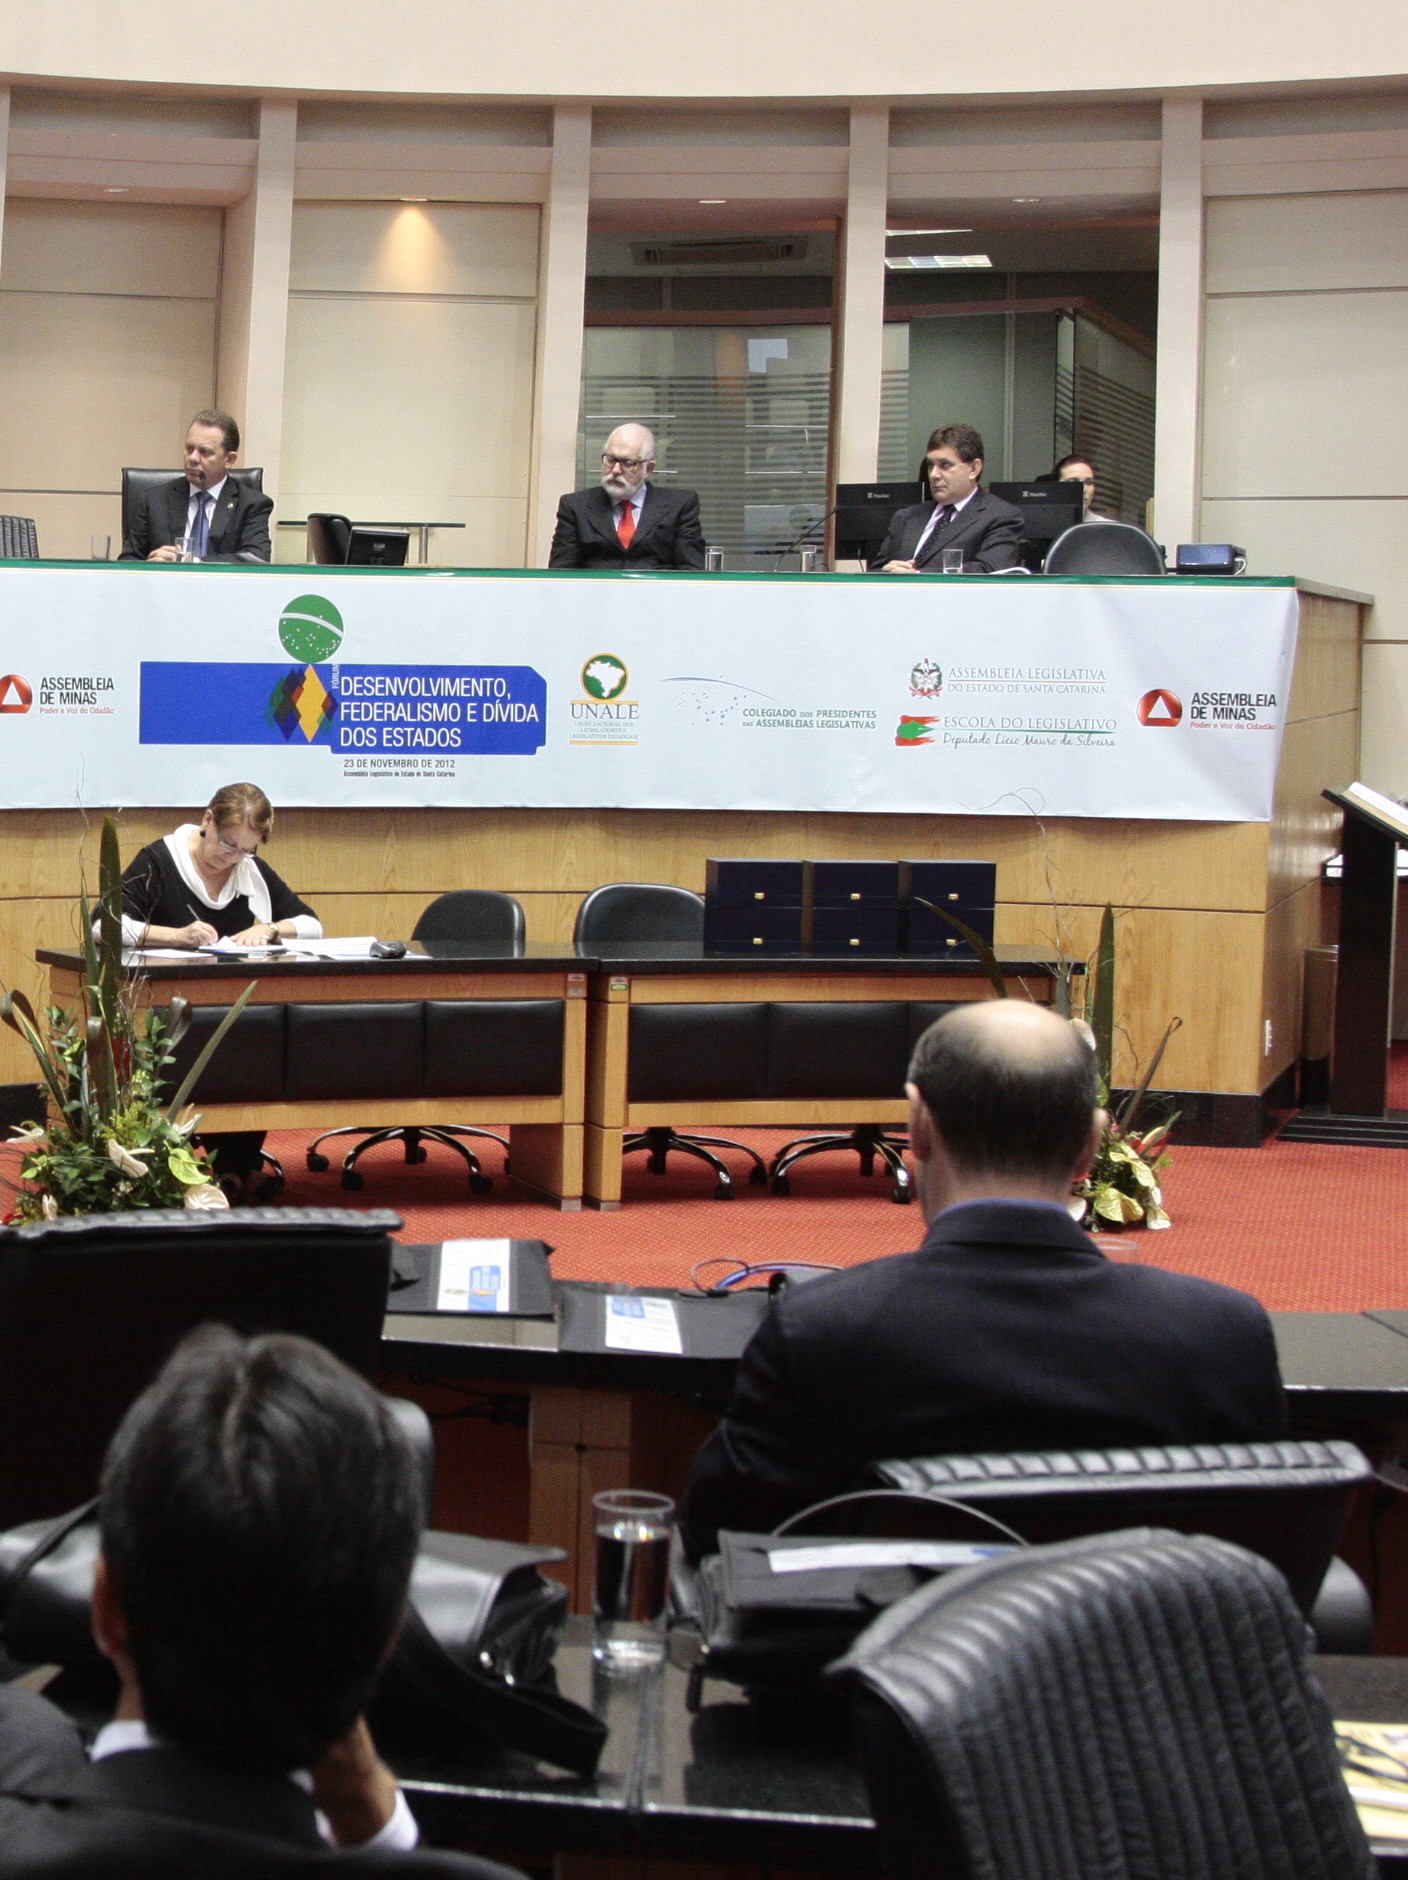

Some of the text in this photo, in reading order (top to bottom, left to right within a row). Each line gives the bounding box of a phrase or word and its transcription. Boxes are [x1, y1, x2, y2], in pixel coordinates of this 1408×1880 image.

[331, 664, 340, 689] FÓRUM
[948, 667, 1106, 680] ASSEMBLEIA LEGISLATIVA
[40, 677, 114, 690] ASSEMBLEIA
[340, 676, 511, 700] DESENVOLVIMENTO,
[948, 684, 1106, 694] DO ESTADO DE SANTA CATARINA
[40, 692, 97, 705] DE MINAS
[1191, 692, 1277, 707] ASSEMBLEIA
[340, 699, 539, 723] FEDERALISMO E DÍVIDA
[570, 704, 640, 720] UNALE
[742, 708, 796, 718] COLEGIADO
[816, 710, 877, 719] PRESIDENTES
[1190, 706, 1256, 721] DE MINAS
[756, 719, 814, 728] ASSEMBLEIAS
[816, 720, 876, 730] LEGISLATIVAS
[944, 716, 1117, 731] ESCOLA DO LEGISLATIVO
[340, 728, 461, 748] DOS ESTADOS
[943, 732, 990, 750] Deputado
[1022, 735, 1056, 746] Mauro
[1060, 734, 1073, 746] da
[1076, 734, 1117, 747] Silveira
[344, 760, 455, 768] 23 DE NOVEMBRO DE 2012
